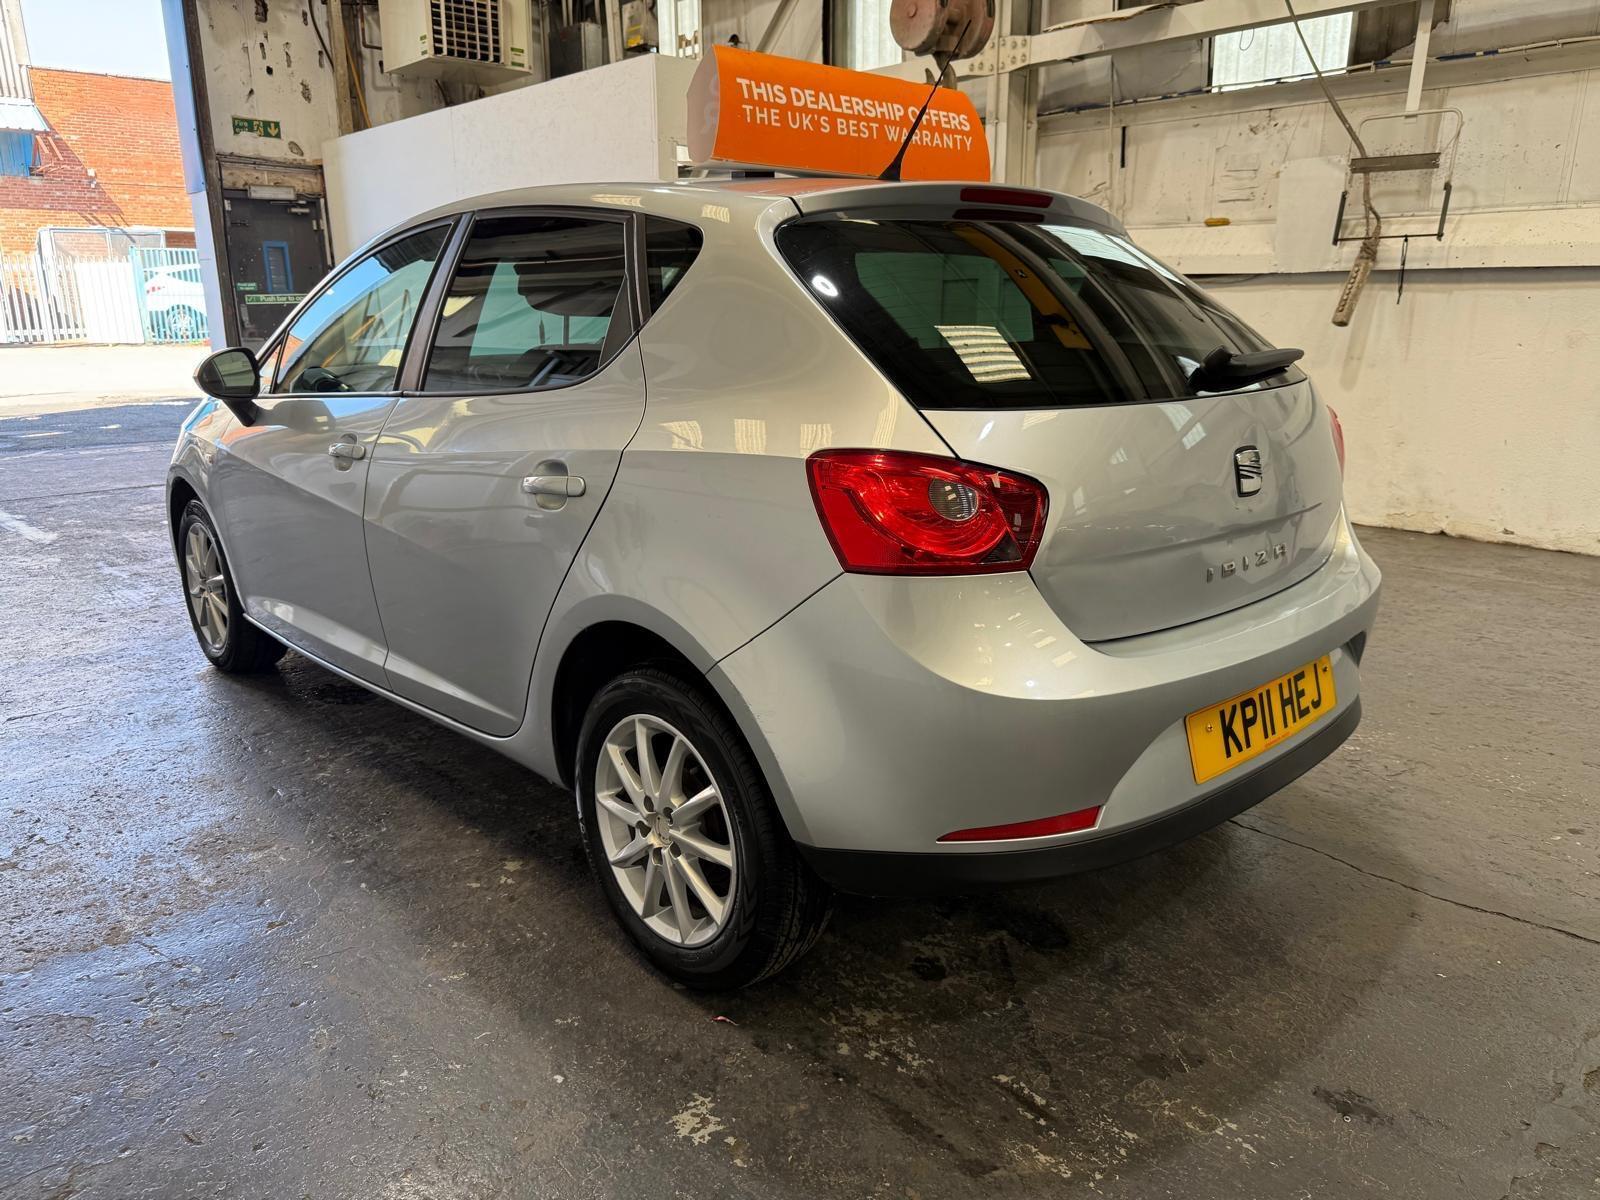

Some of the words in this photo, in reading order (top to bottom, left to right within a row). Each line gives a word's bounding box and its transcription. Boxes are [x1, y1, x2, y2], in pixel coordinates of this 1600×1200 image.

[736, 77, 787, 105] THIS
[790, 87, 904, 121] DEALERSHIP
[907, 105, 971, 132] OFFERS
[742, 104, 781, 128] THE
[788, 111, 830, 134] UK'S
[837, 118, 880, 140] BEST
[884, 124, 973, 152] WARRANTY
[1206, 542, 1287, 583] IBIZA
[1278, 663, 1323, 730] HEJ
